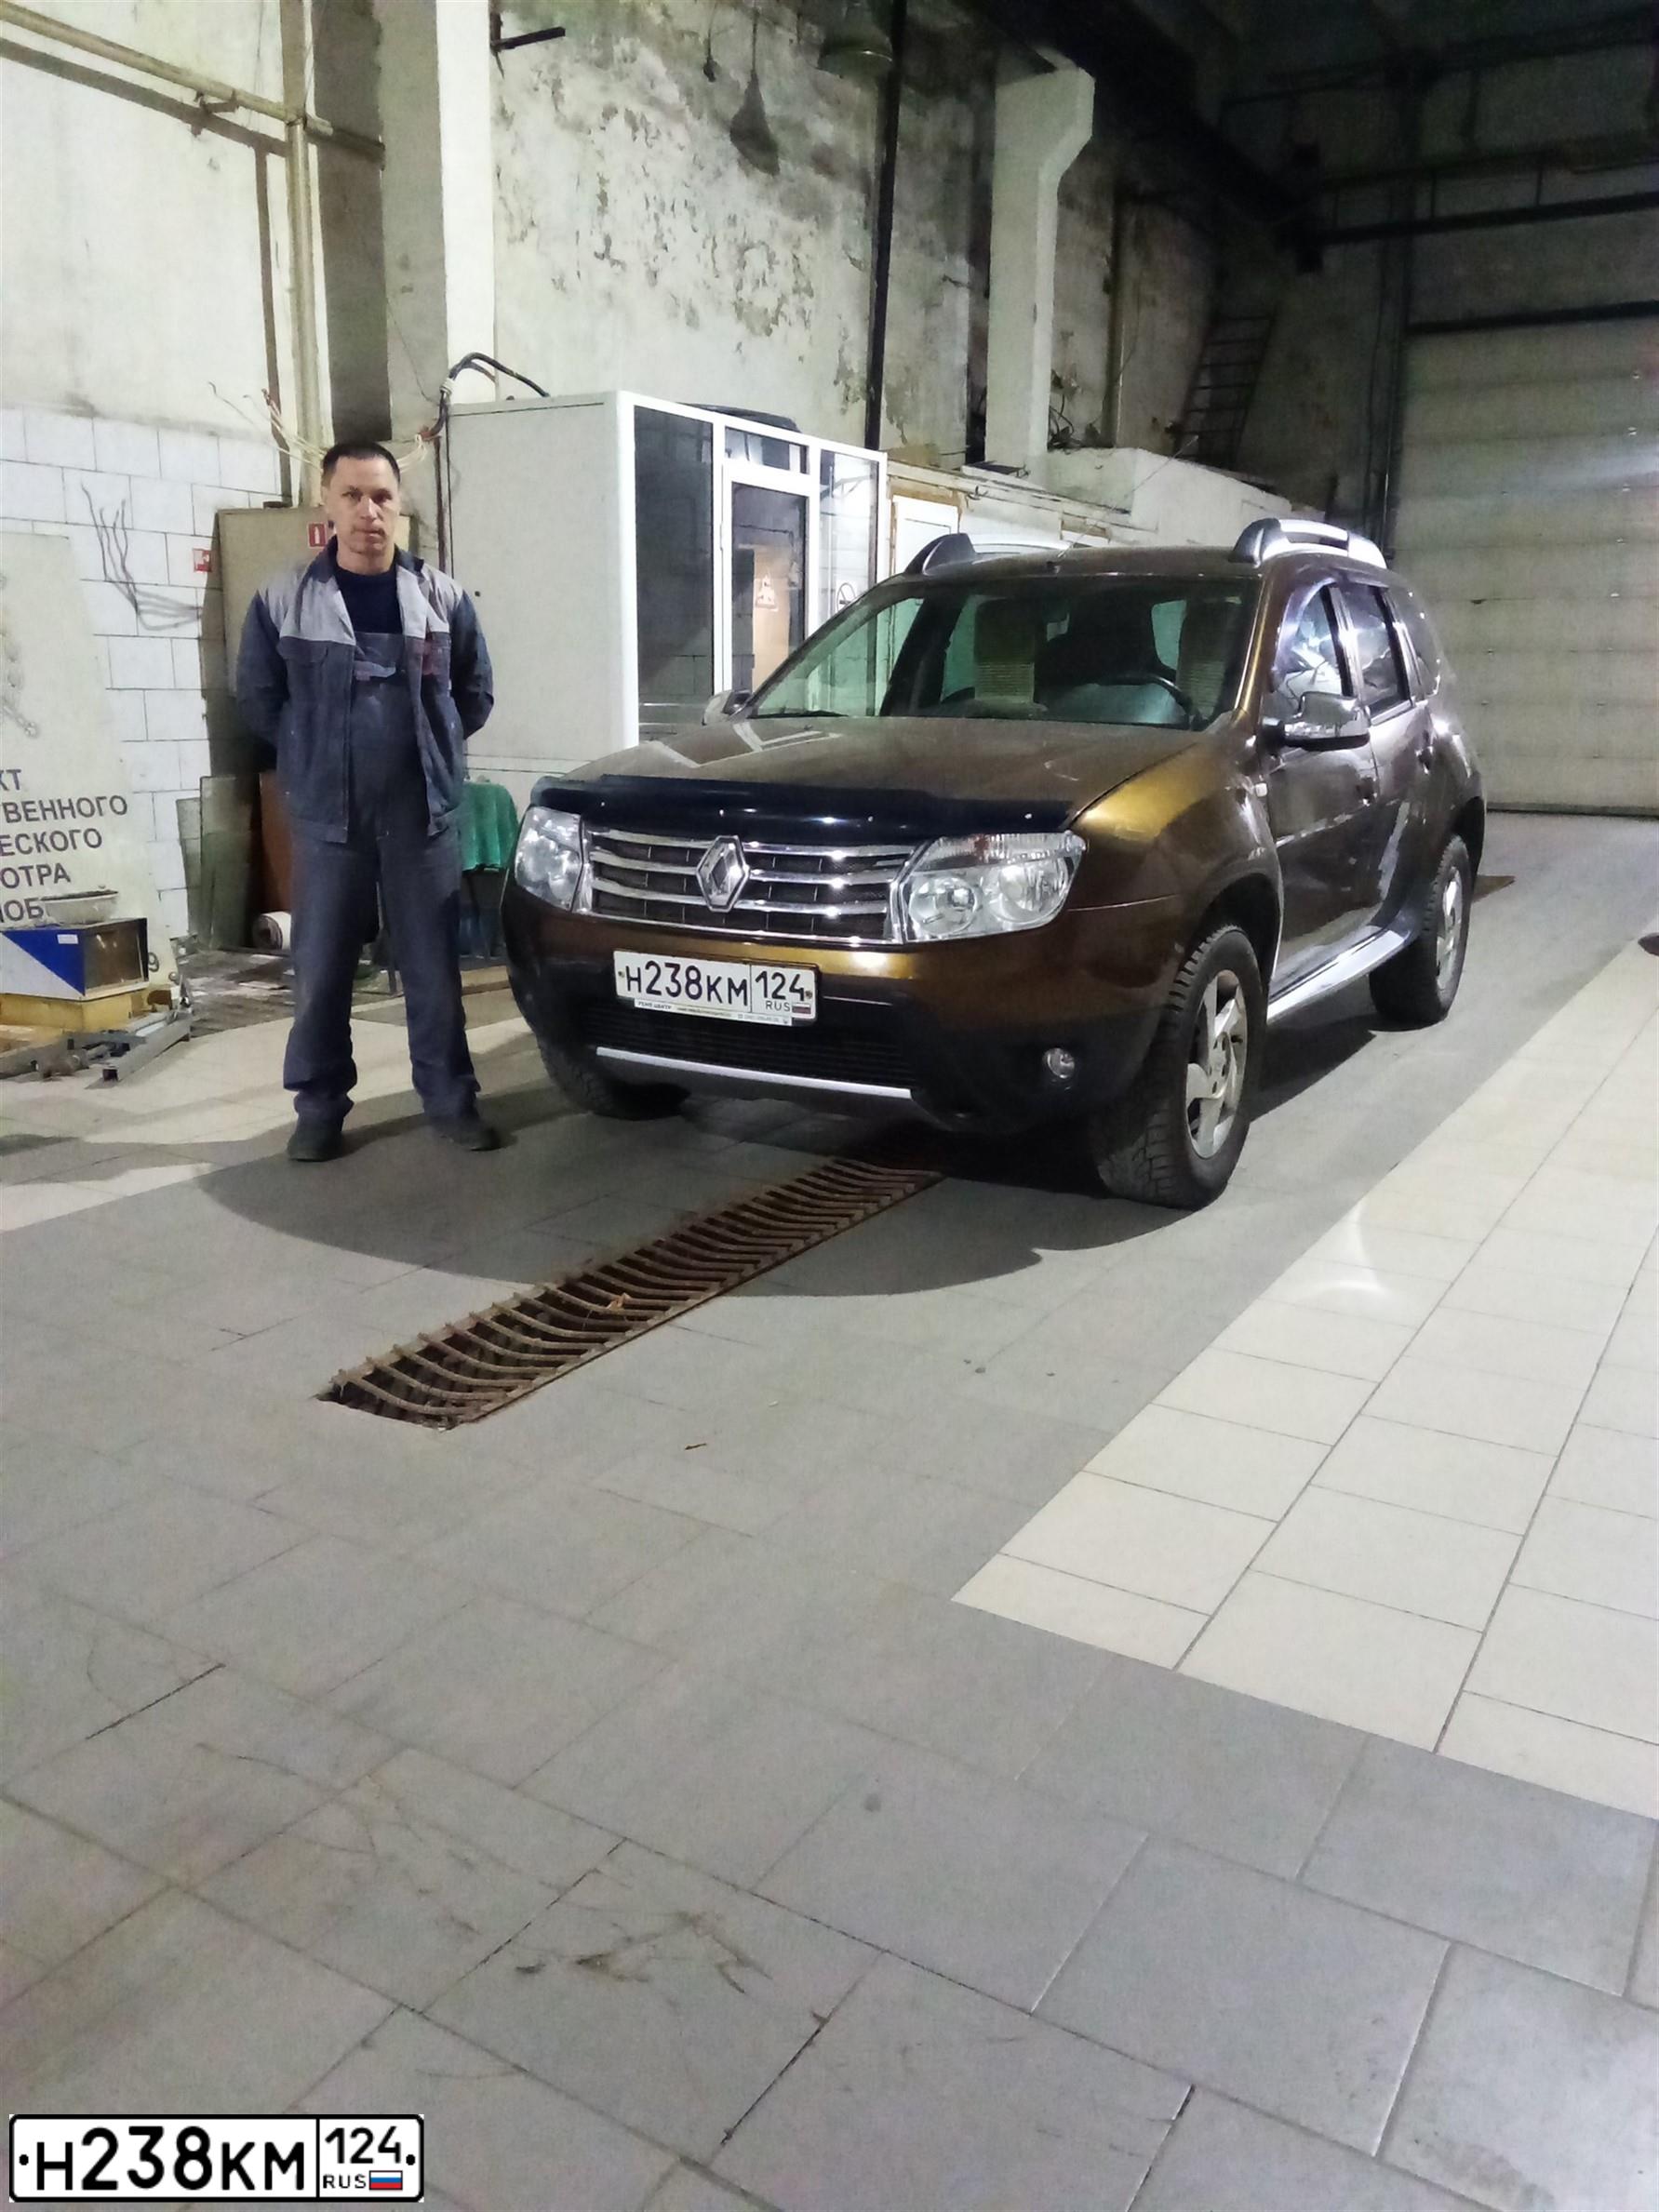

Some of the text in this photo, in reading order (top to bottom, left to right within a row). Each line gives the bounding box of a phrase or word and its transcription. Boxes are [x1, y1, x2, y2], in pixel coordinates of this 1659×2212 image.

[2, 795, 127, 823] ВЕННОГО
[0, 863, 71, 888] ОТРА
[625, 960, 805, 1006] Н238КМ 124
[766, 1000, 790, 1012] RUS
